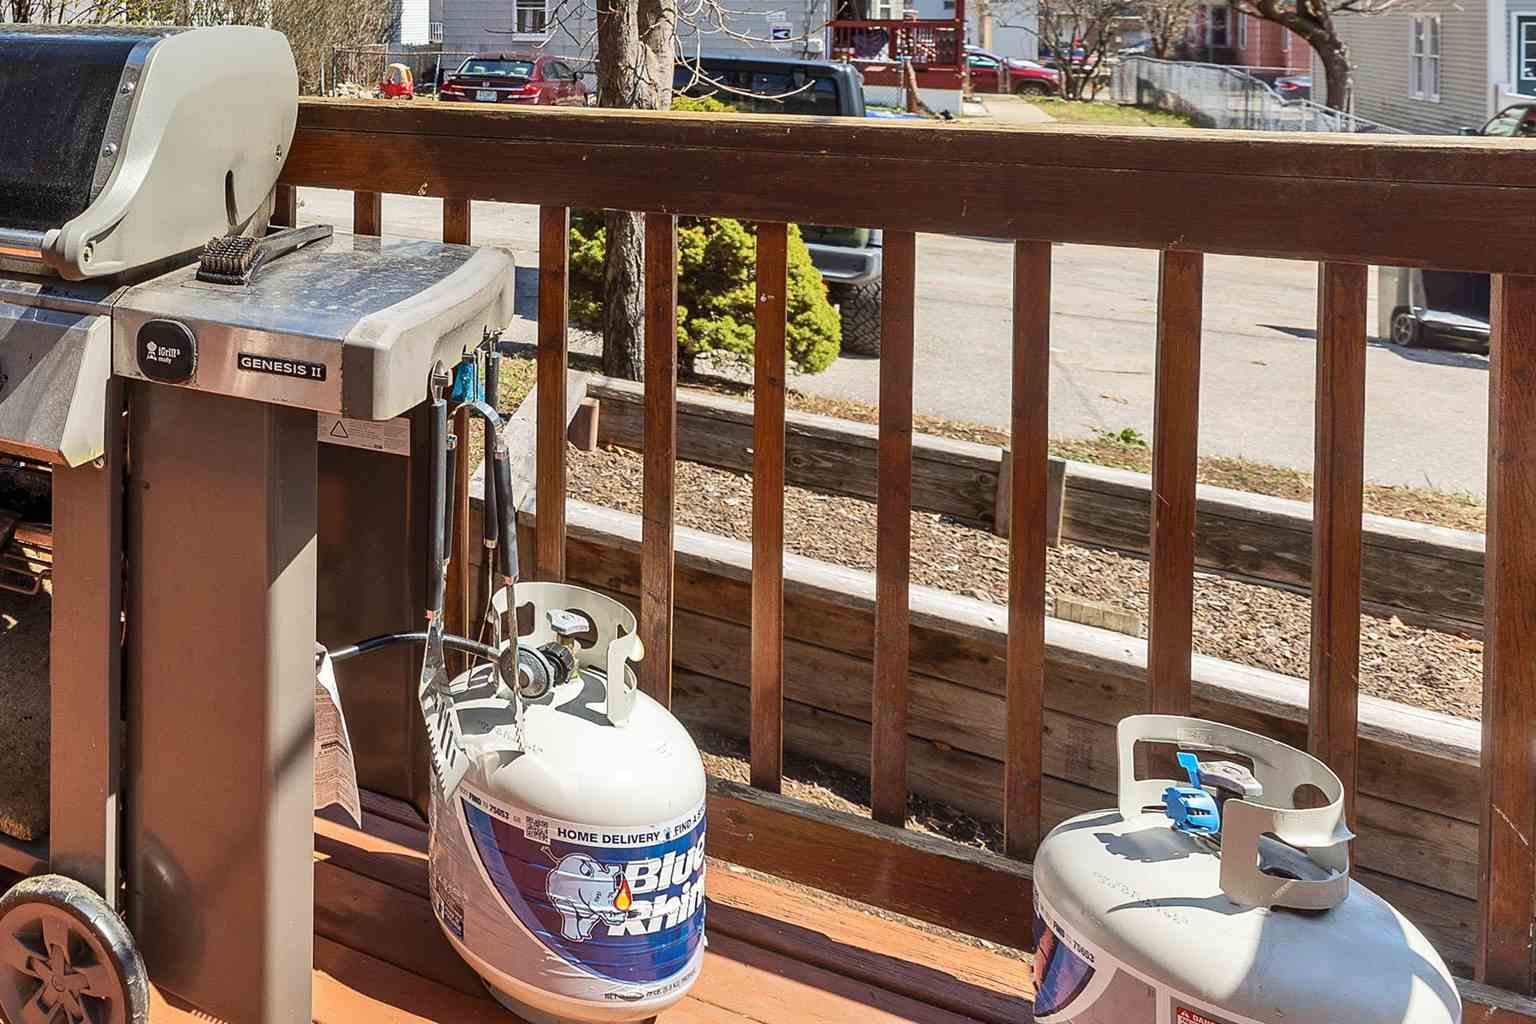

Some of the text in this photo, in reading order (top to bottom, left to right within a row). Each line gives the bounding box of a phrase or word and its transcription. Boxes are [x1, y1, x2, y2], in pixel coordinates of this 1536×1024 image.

[240, 357, 322, 378] GENESIS II
[557, 827, 660, 844] HOME DELIVERY
[674, 819, 692, 836] FIND
[625, 833, 705, 895] Blue
[607, 874, 705, 936] Rhin
